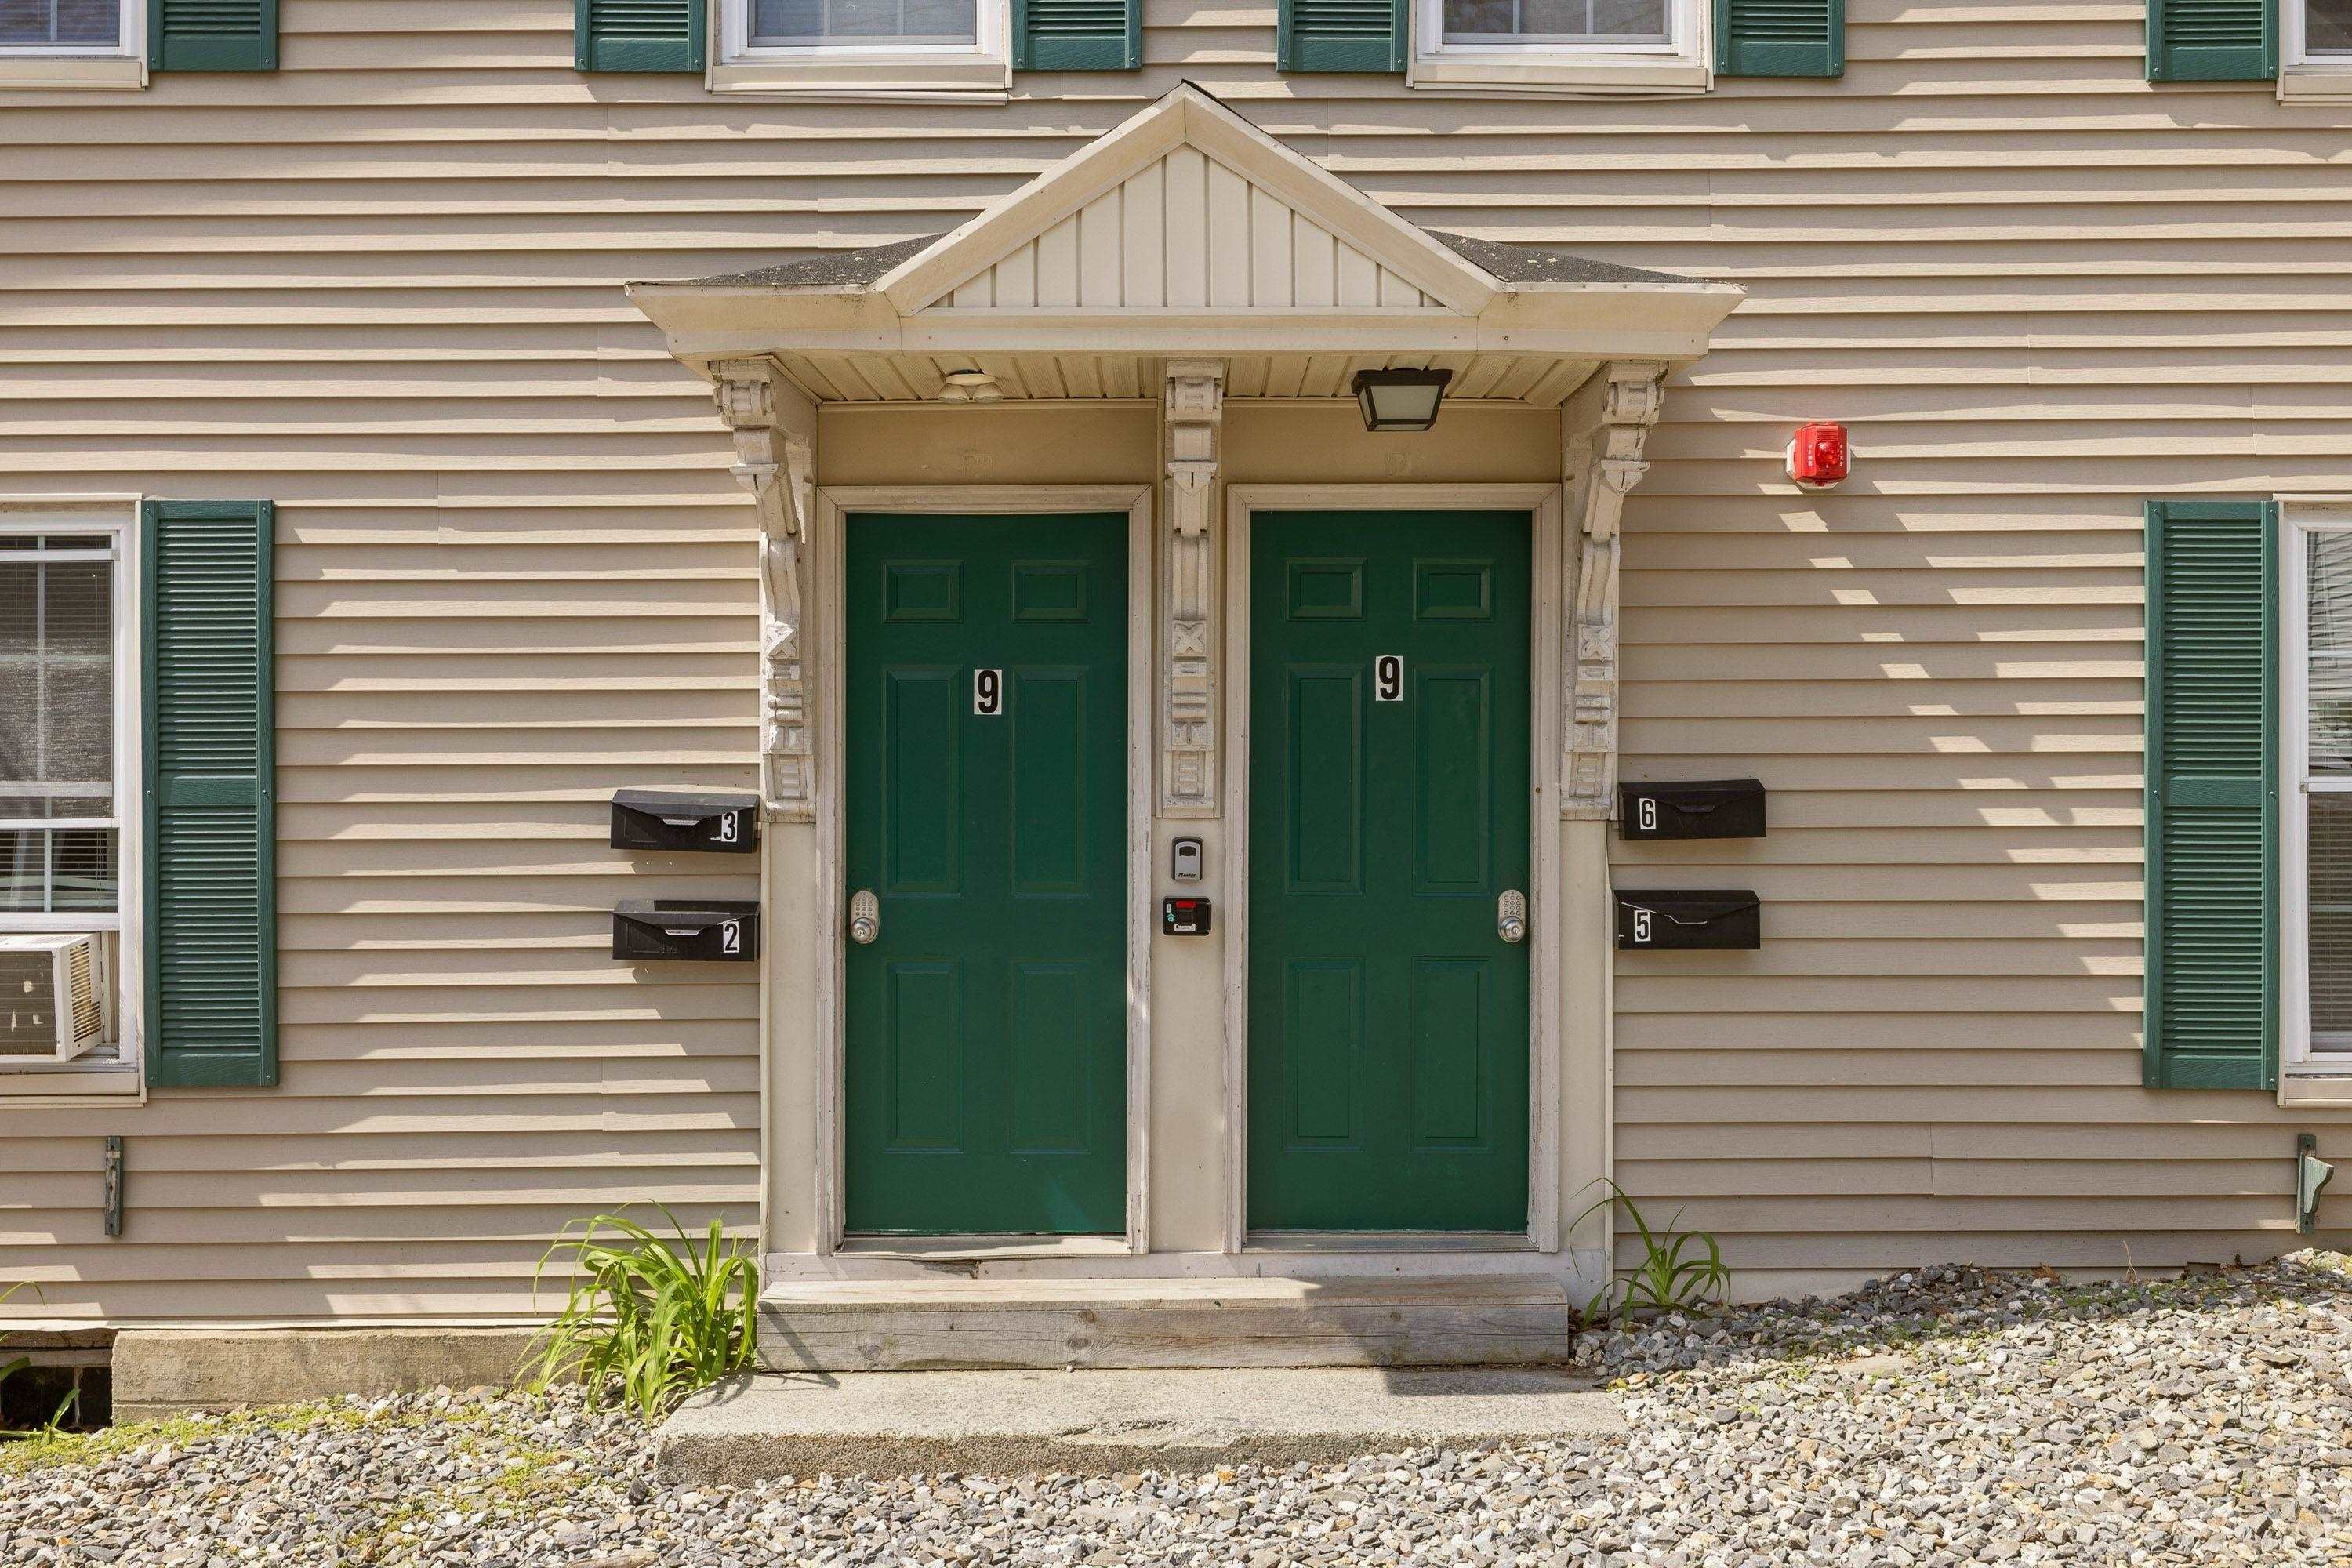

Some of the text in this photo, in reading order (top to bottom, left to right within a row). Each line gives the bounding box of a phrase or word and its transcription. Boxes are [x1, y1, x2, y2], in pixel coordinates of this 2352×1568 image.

[977, 670, 999, 714] 9
[1378, 655, 1400, 701] 9
[723, 811, 737, 841] 3
[1641, 799, 1655, 828] 6
[724, 922, 738, 952] 2
[1636, 911, 1650, 940] 5
